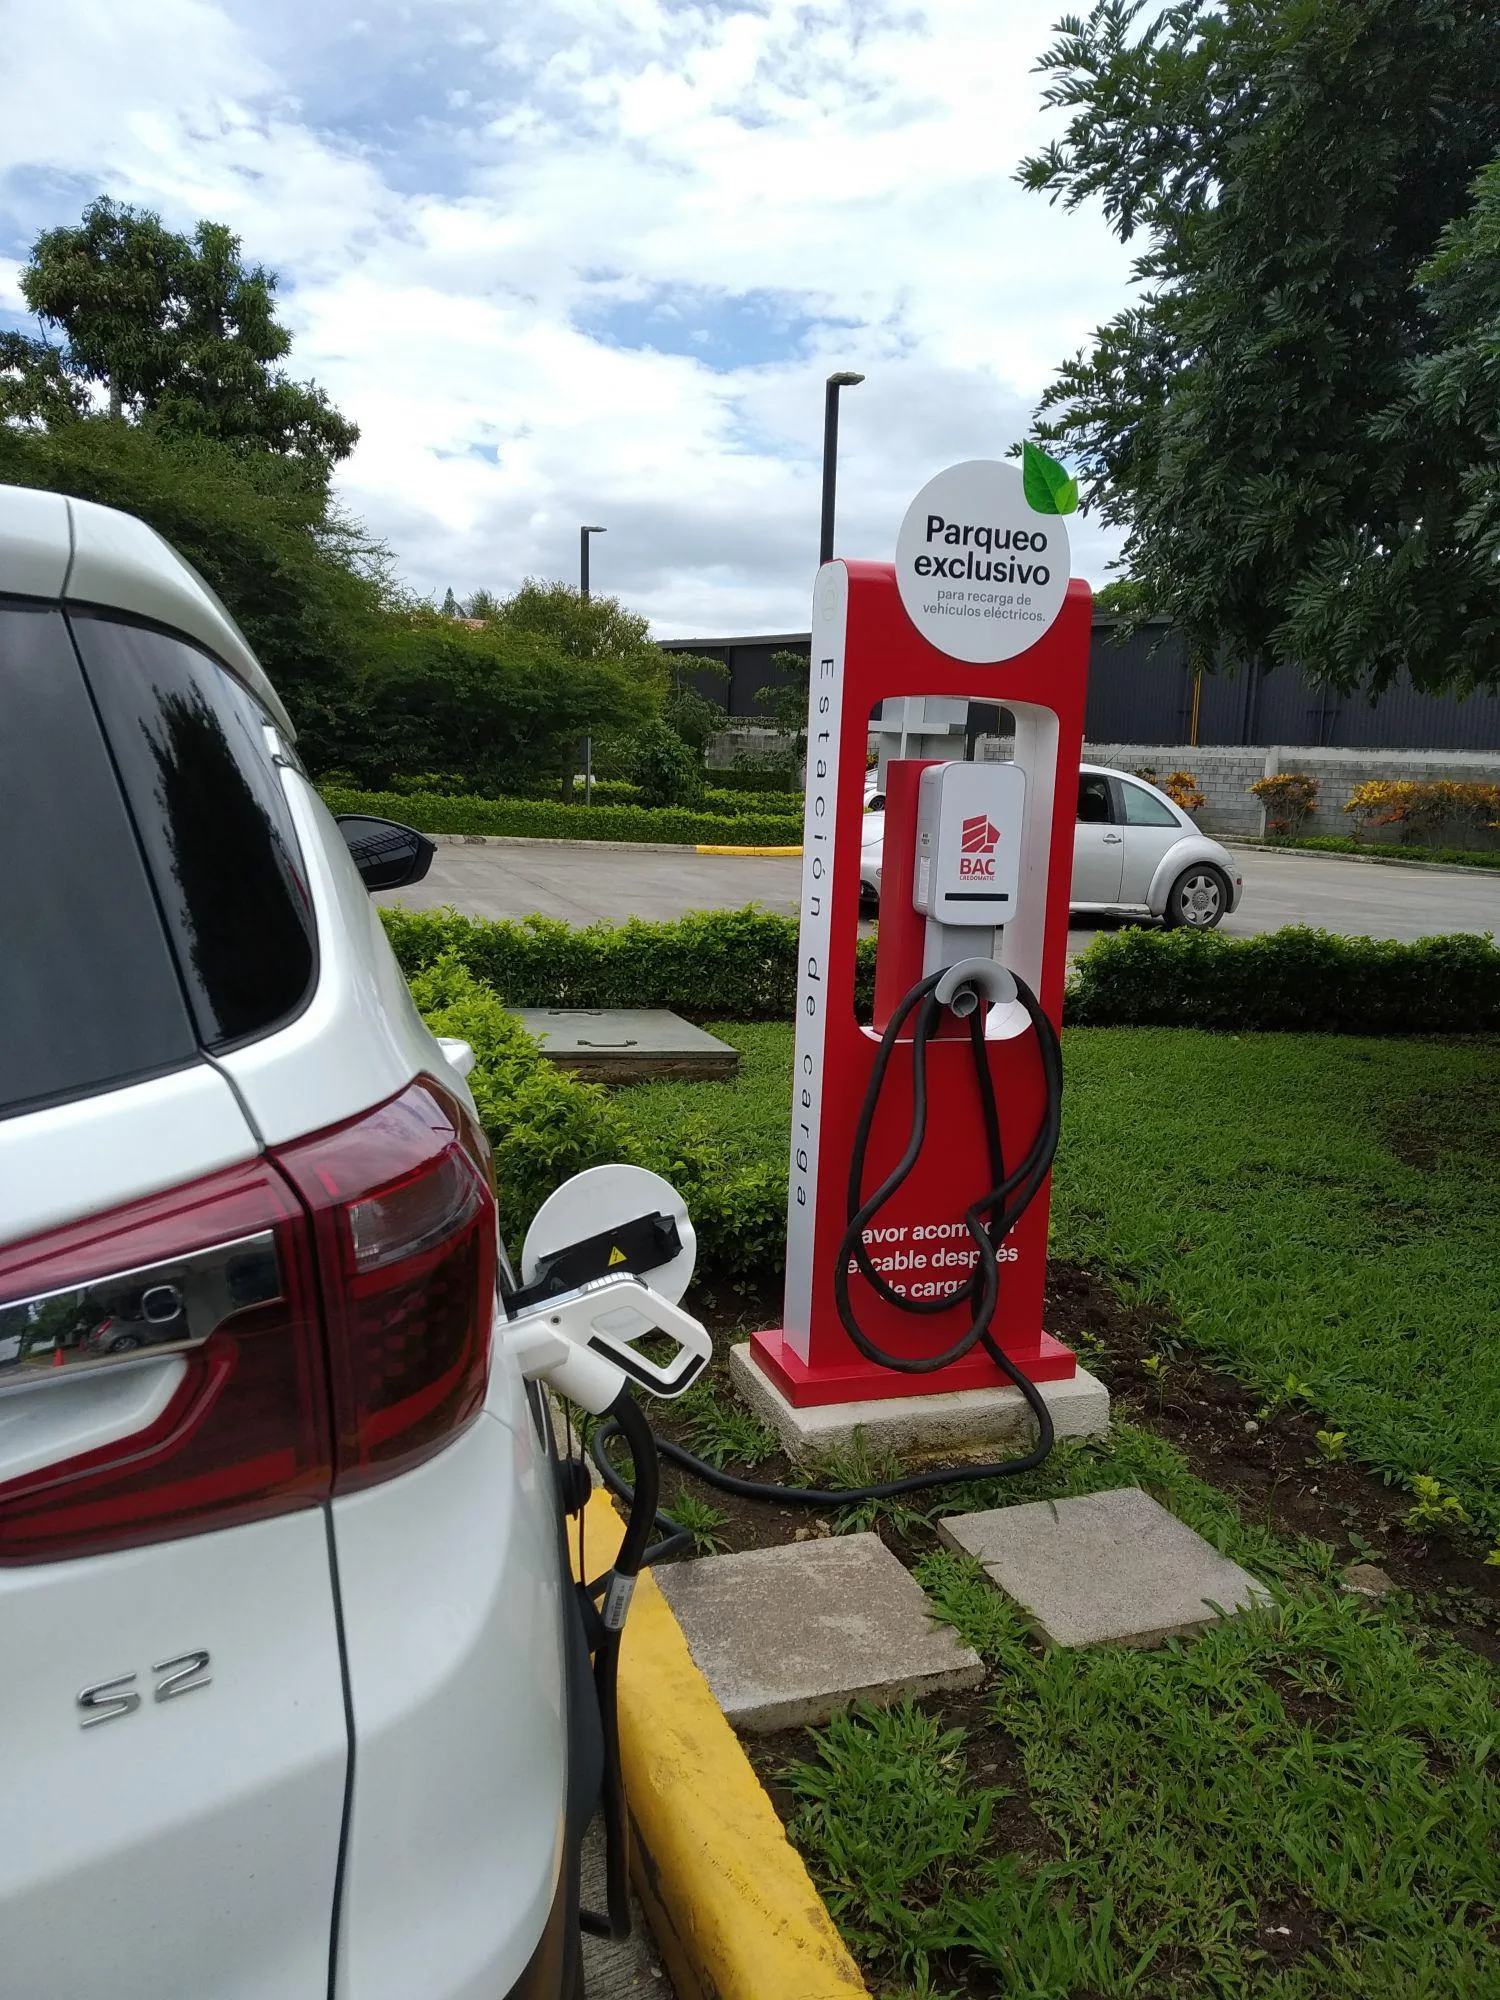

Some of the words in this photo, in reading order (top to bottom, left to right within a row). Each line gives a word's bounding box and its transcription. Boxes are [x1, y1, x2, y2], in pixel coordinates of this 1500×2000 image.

[926, 515, 1048, 554] Parqueo
[914, 551, 1051, 586] exclusivo
[923, 602, 981, 618] vehículos
[983, 606, 1046, 622] eléctricos.
[937, 588, 965, 602] para
[967, 591, 1014, 606] recarga
[1016, 593, 1032, 606] de
[810, 658, 834, 917] Estación
[959, 857, 996, 876] BAC
[807, 956, 820, 1017] de
[796, 1054, 813, 1207] carga
[861, 1225, 908, 1244] avor
[870, 1249, 927, 1272] cable
[931, 1243, 1019, 1269] despés
[75, 1648, 213, 1730] S2
